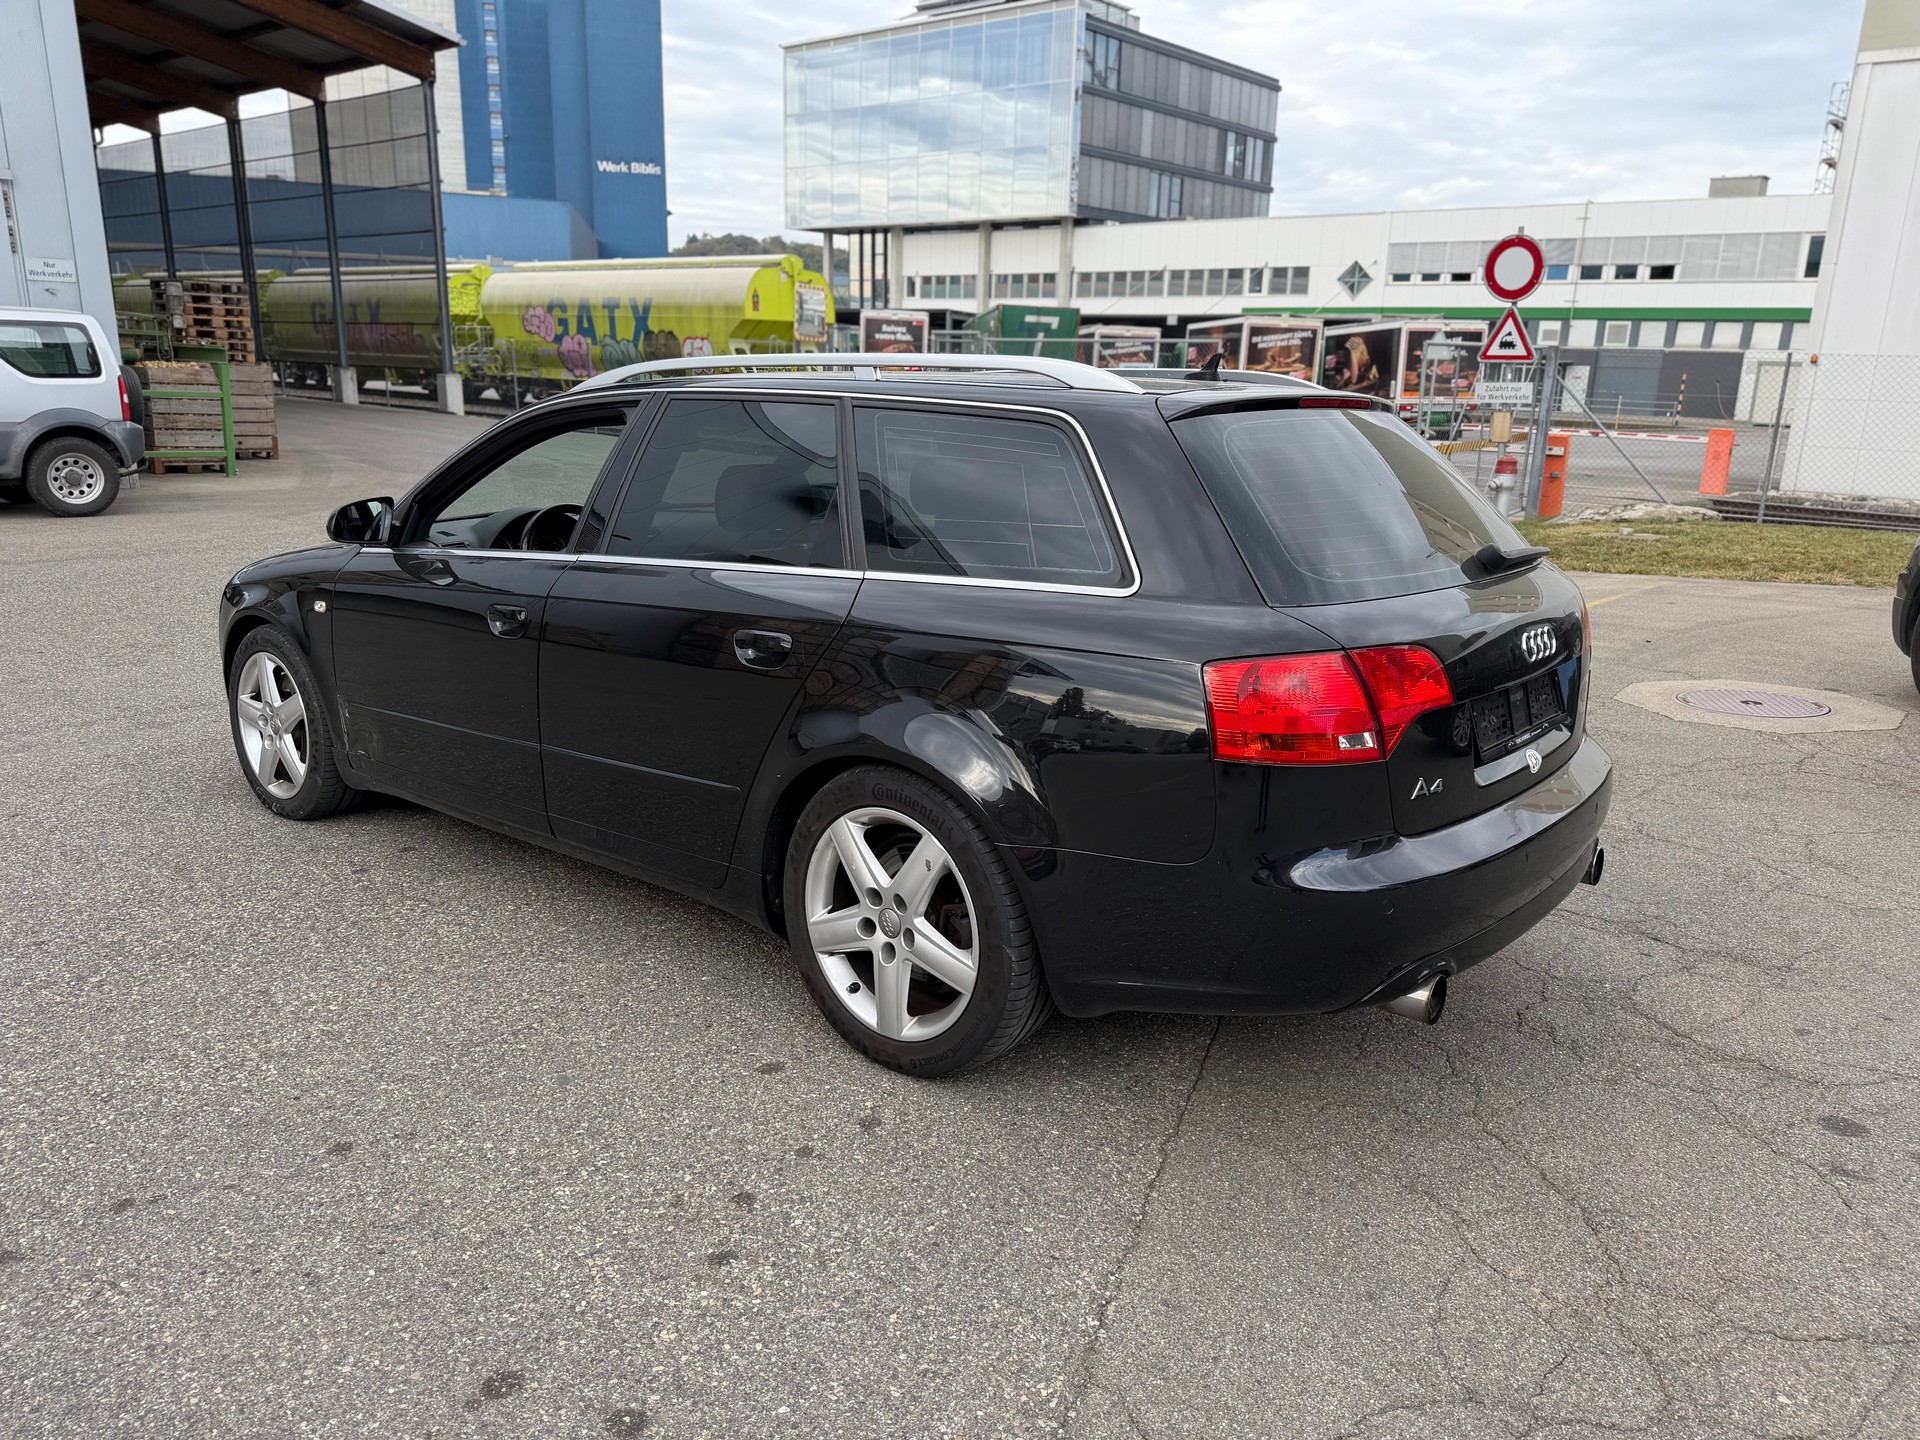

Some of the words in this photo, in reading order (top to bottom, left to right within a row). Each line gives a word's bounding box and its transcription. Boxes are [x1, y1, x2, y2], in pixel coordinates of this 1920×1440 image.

[597, 160, 629, 173] Werk
[631, 161, 661, 175] Biblis
[43, 261, 56, 269] Nur
[28, 269, 73, 278] Werkverkehr
[547, 297, 653, 347] GATX
[1485, 384, 1509, 392] Zufahrt
[1477, 393, 1486, 401] für
[1488, 393, 1530, 401] Werkverkehr
[1410, 777, 1443, 800] A4
[871, 782, 946, 832] Continental
